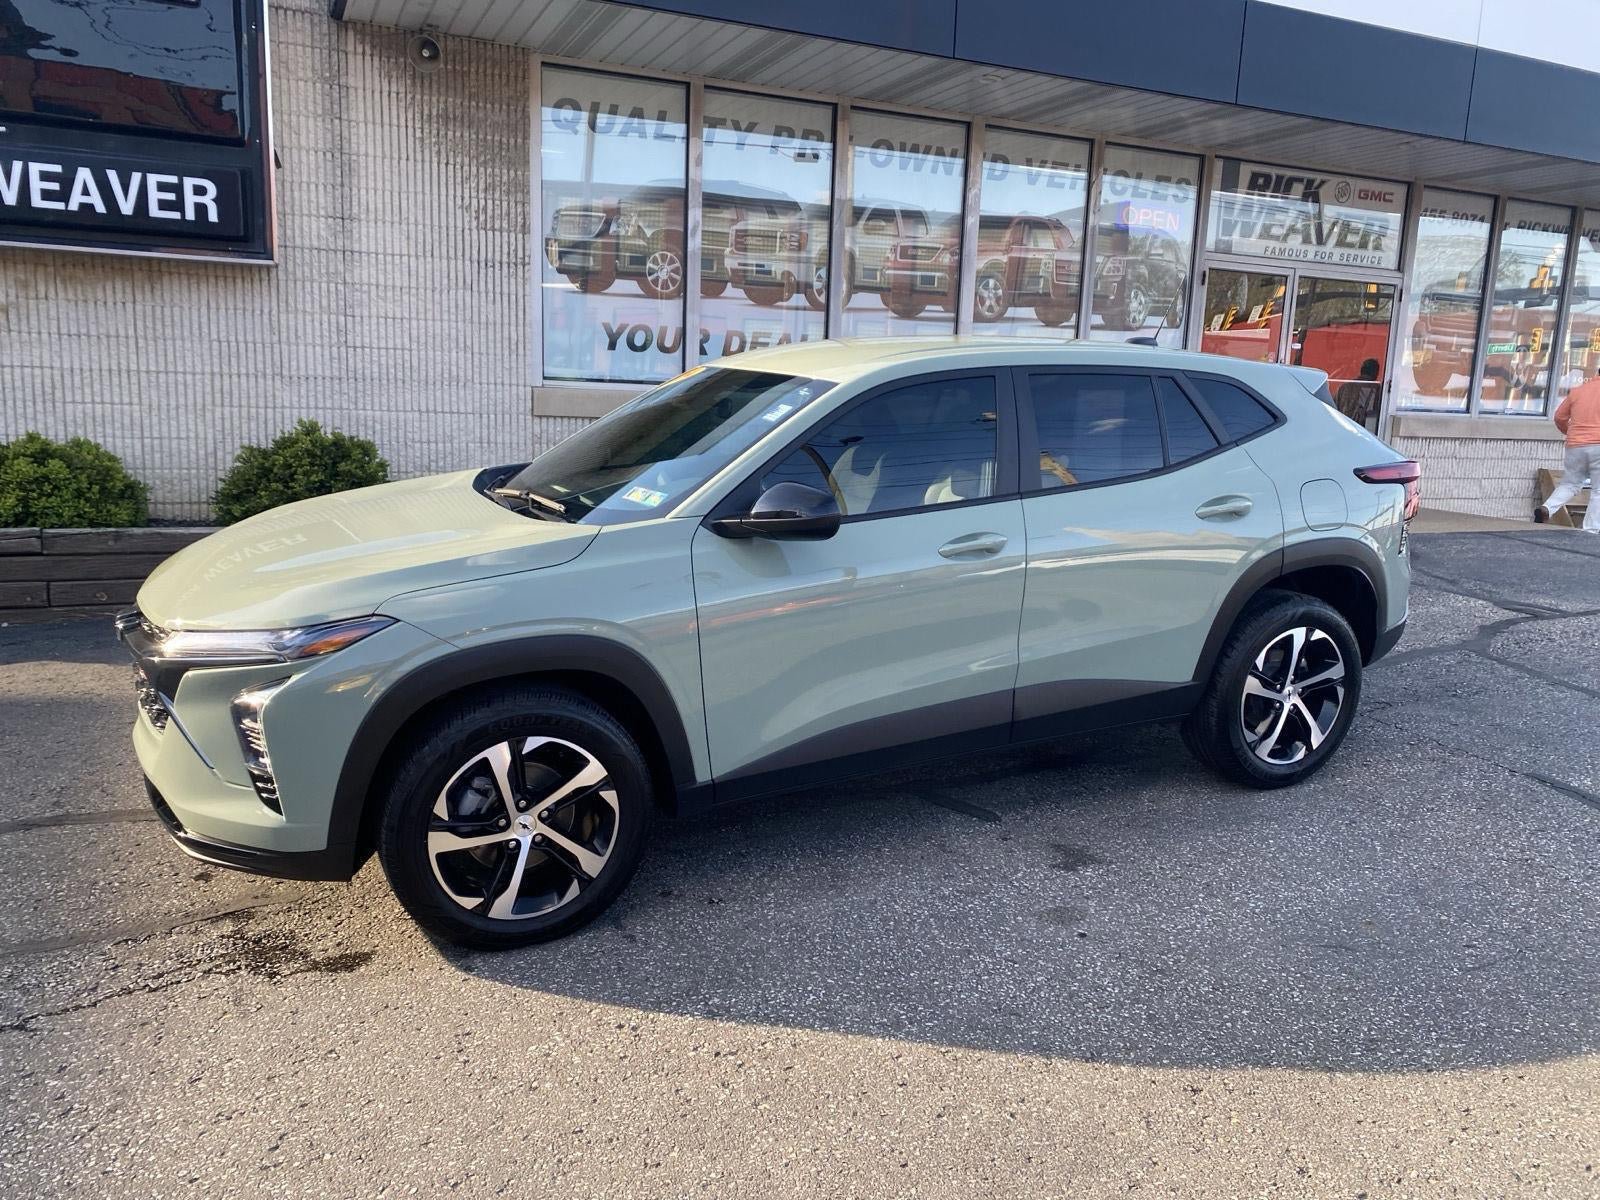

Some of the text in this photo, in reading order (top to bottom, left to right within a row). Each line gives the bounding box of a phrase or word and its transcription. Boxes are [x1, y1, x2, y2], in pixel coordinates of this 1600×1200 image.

[551, 98, 1192, 204] QUALTY PR-OWND VEHCLES
[1246, 171, 1328, 204] RICK
[1357, 188, 1395, 203] GMC
[1122, 207, 1180, 231] OPEN
[1263, 246, 1383, 265] FAMOUS FOR SERVICE
[602, 322, 809, 357] YOUR DEA
